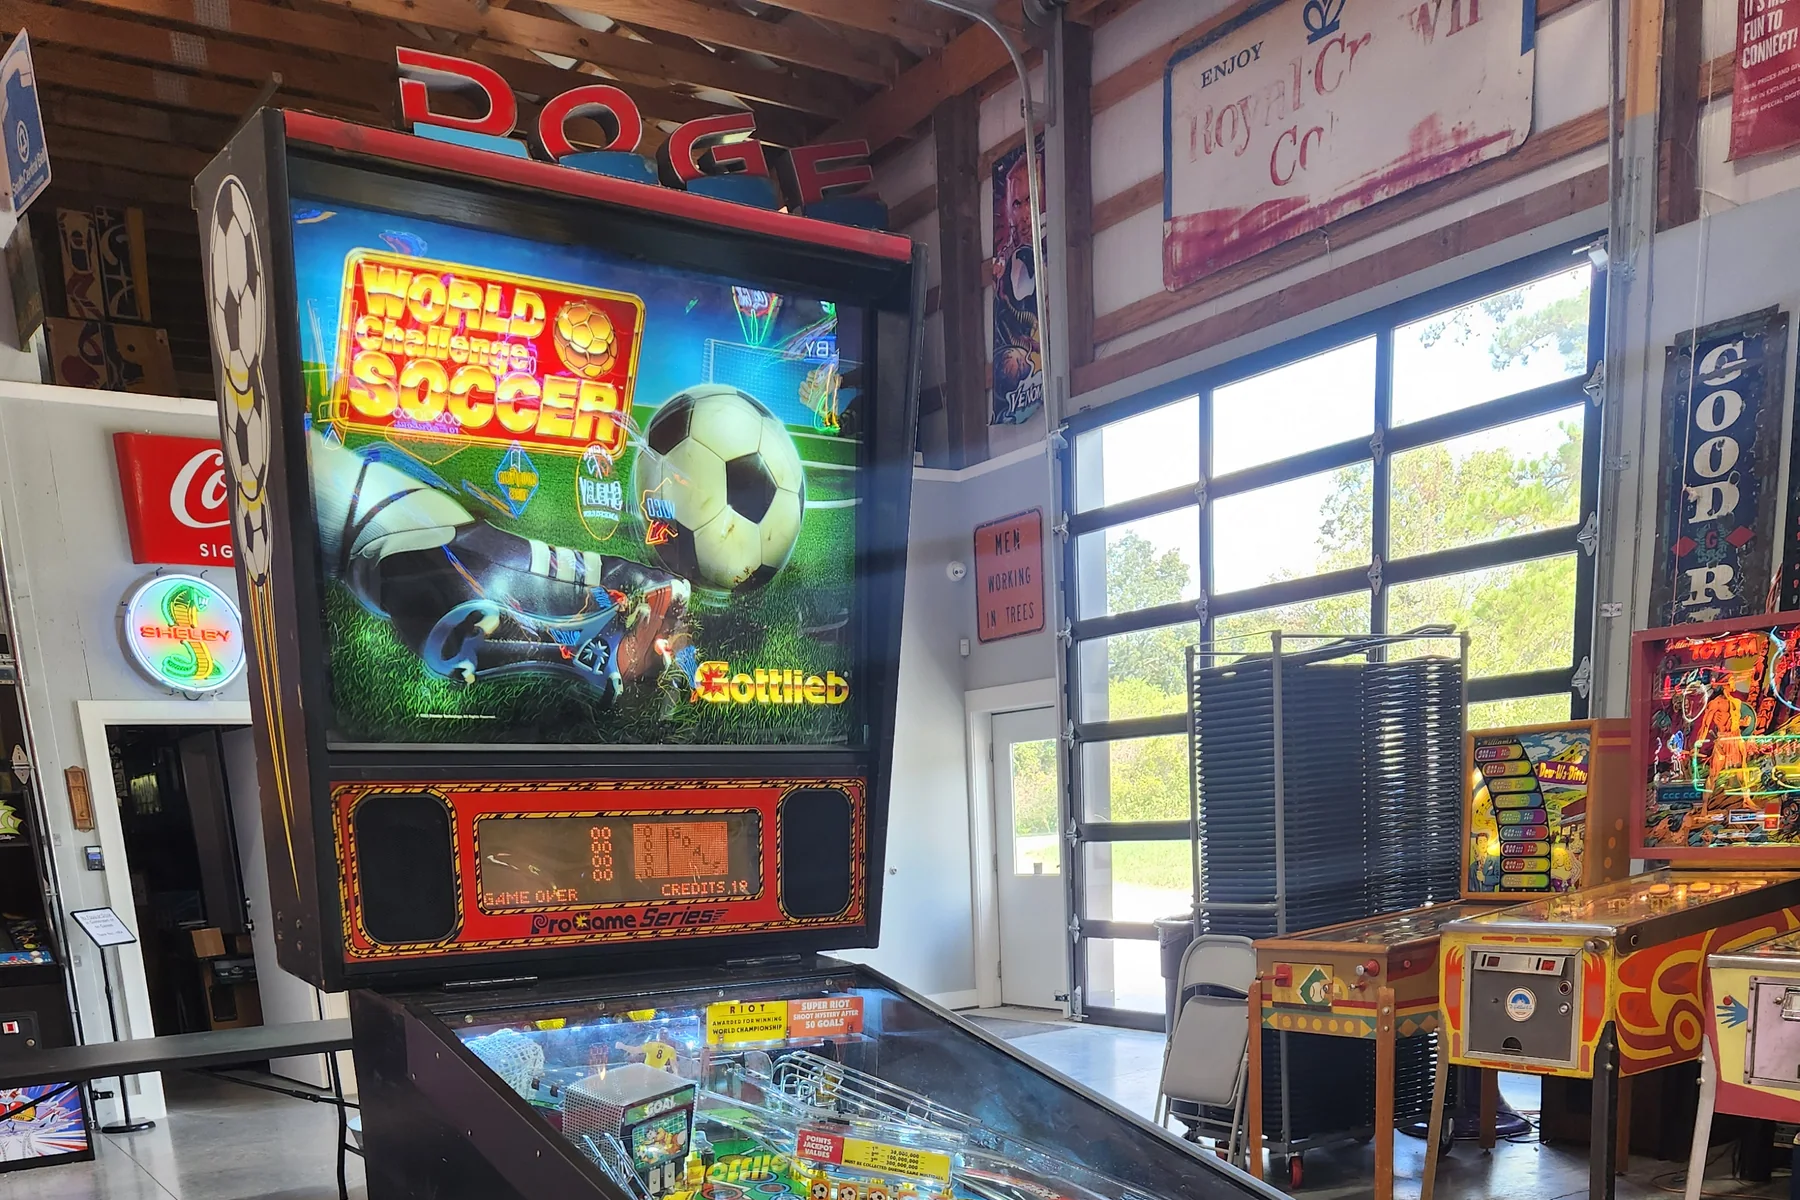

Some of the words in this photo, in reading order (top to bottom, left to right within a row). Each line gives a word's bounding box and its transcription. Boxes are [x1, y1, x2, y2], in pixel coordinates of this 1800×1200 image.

[1743, 15, 1765, 44] FUN
[1767, 9, 1783, 33] TO
[1742, 27, 1799, 69] CONNECT!
[1200, 41, 1265, 89] ENJOY
[1778, 66, 1790, 77] AND
[1766, 77, 1797, 95] EXCLUSIVE
[1760, 97, 1784, 111] SPECIAL
[361, 264, 547, 338] WORLD
[355, 314, 534, 375] Challenge
[350, 350, 619, 442] SOCCER
[1688, 339, 1748, 526] GOOD
[995, 527, 1021, 556] MEN
[988, 566, 1031, 594] WORKING
[986, 610, 997, 629] IN
[1005, 602, 1035, 625] TREES
[140, 623, 232, 642] SHELBY
[1689, 637, 1758, 661] TOTEM
[695, 660, 850, 705] Gottlieb
[484, 890, 531, 905] GAME
[535, 889, 579, 904] OVER
[661, 881, 726, 896] CREDITS
[639, 906, 720, 928] Series
[730, 1004, 766, 1014] RIOT
[801, 1002, 828, 1011] SUPER
[829, 1000, 850, 1009] RIOT
[815, 1011, 840, 1019] MYSTERY
[840, 1009, 859, 1017] AFTER
[712, 1027, 736, 1035] WORLD
[736, 1025, 783, 1033] CHAMPIONSHIP
[805, 1020, 817, 1029] 50
[817, 1018, 844, 1028] GOALS
[656, 1049, 663, 1059] 8
[646, 1095, 676, 1118] GOAL
[803, 1141, 834, 1153] JACKPOT
[806, 1134, 832, 1146] POINTS
[804, 1148, 830, 1159] VALUES
[863, 1162, 888, 1171] COLLECTED
[888, 1166, 906, 1174] DURING
